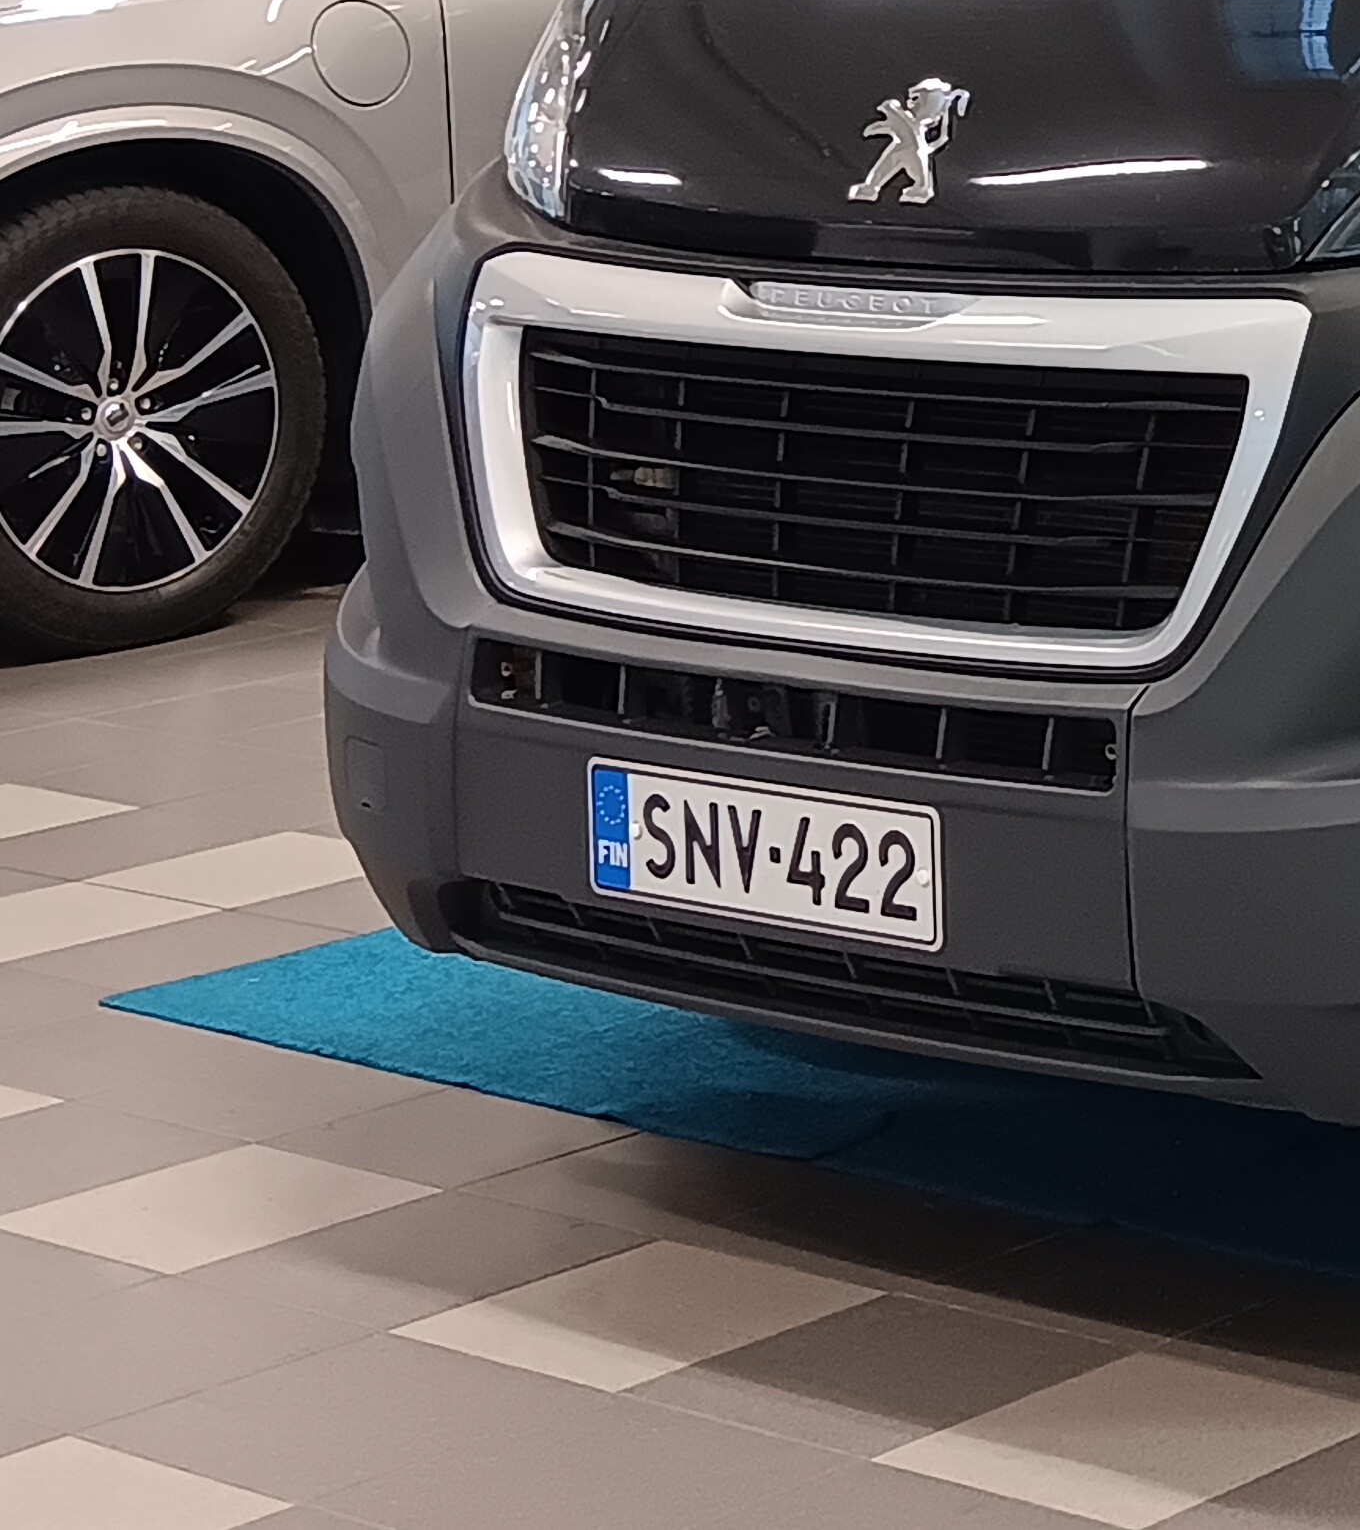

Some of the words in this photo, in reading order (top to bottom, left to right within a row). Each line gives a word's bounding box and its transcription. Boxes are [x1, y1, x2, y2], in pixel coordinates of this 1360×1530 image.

[769, 285, 939, 315] PEUGEOT
[598, 839, 629, 868] FIN
[642, 793, 918, 922] SNV-422
